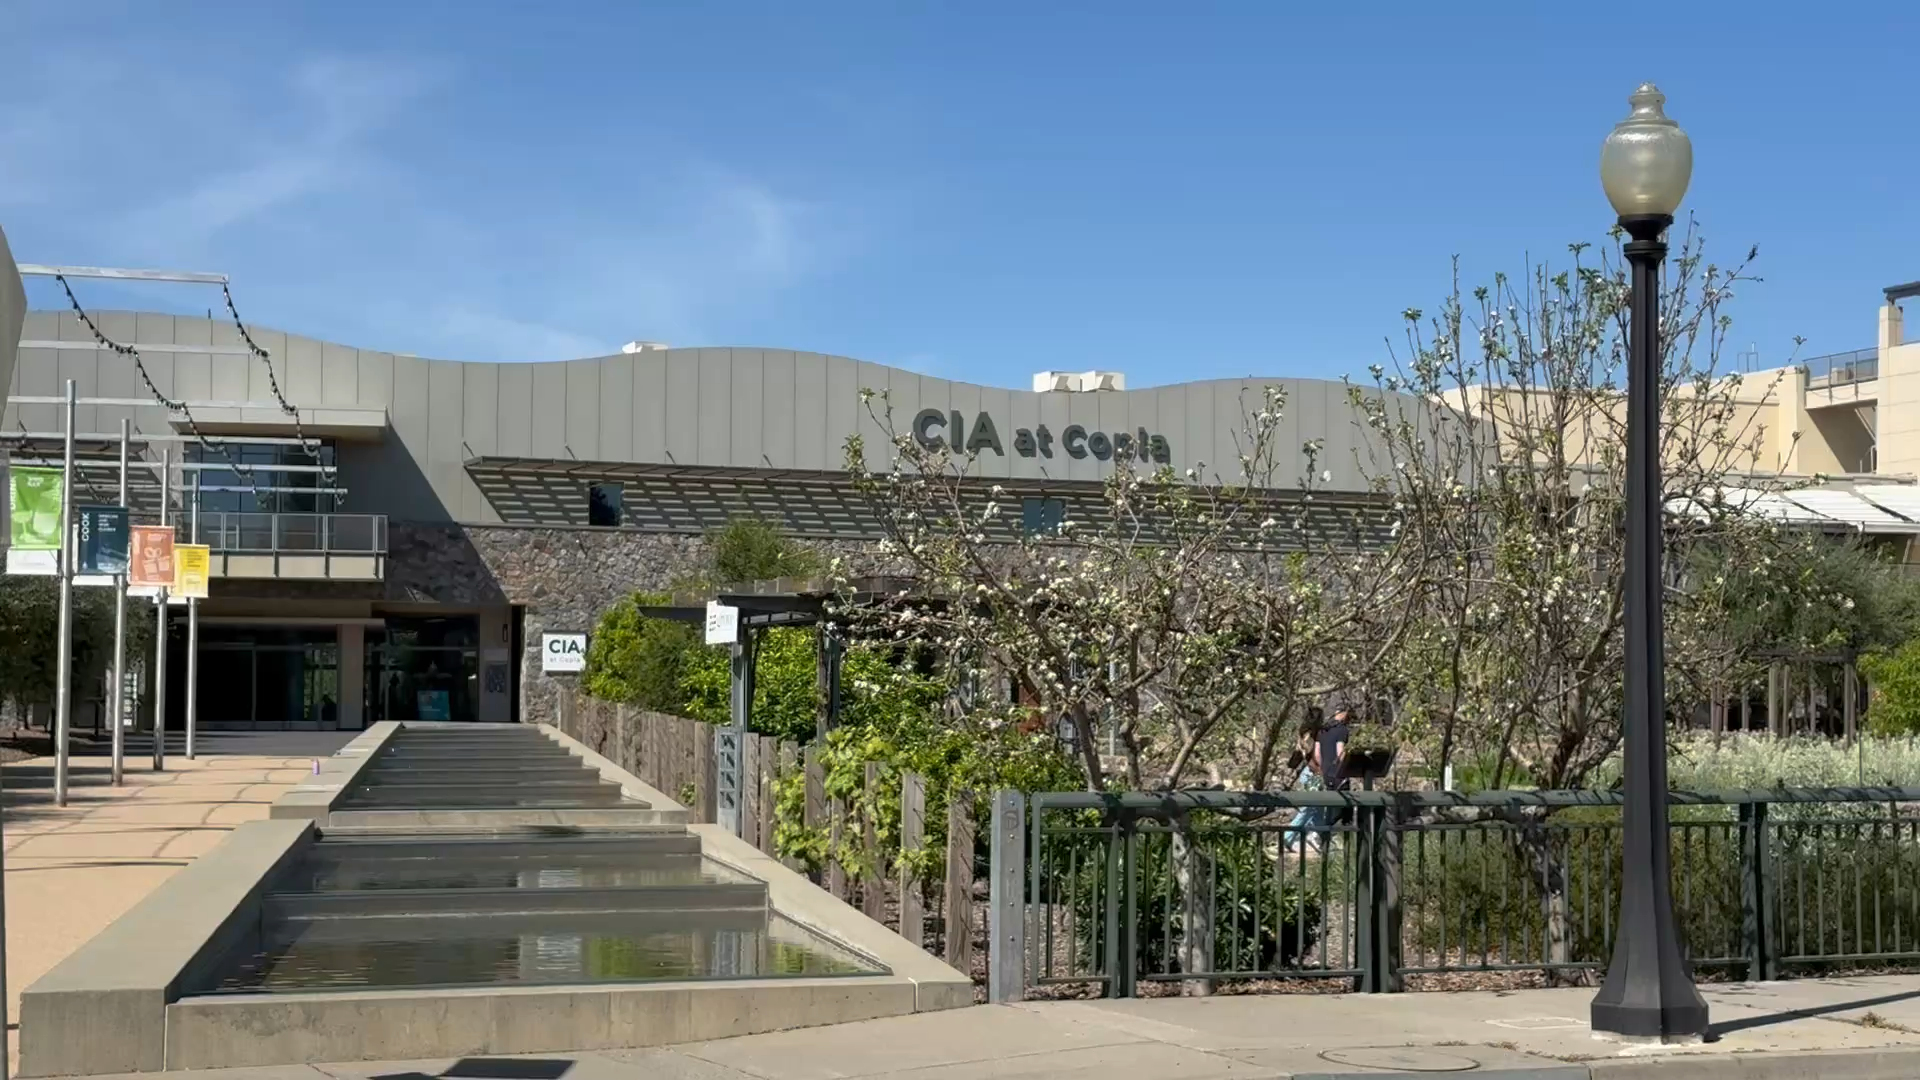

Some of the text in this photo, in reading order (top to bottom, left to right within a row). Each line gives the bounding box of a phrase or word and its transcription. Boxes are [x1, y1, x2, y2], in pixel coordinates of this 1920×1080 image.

[913, 408, 1004, 456] CIA
[1014, 424, 1053, 458] at
[82, 513, 90, 541] COOK
[549, 639, 580, 654] CIA
